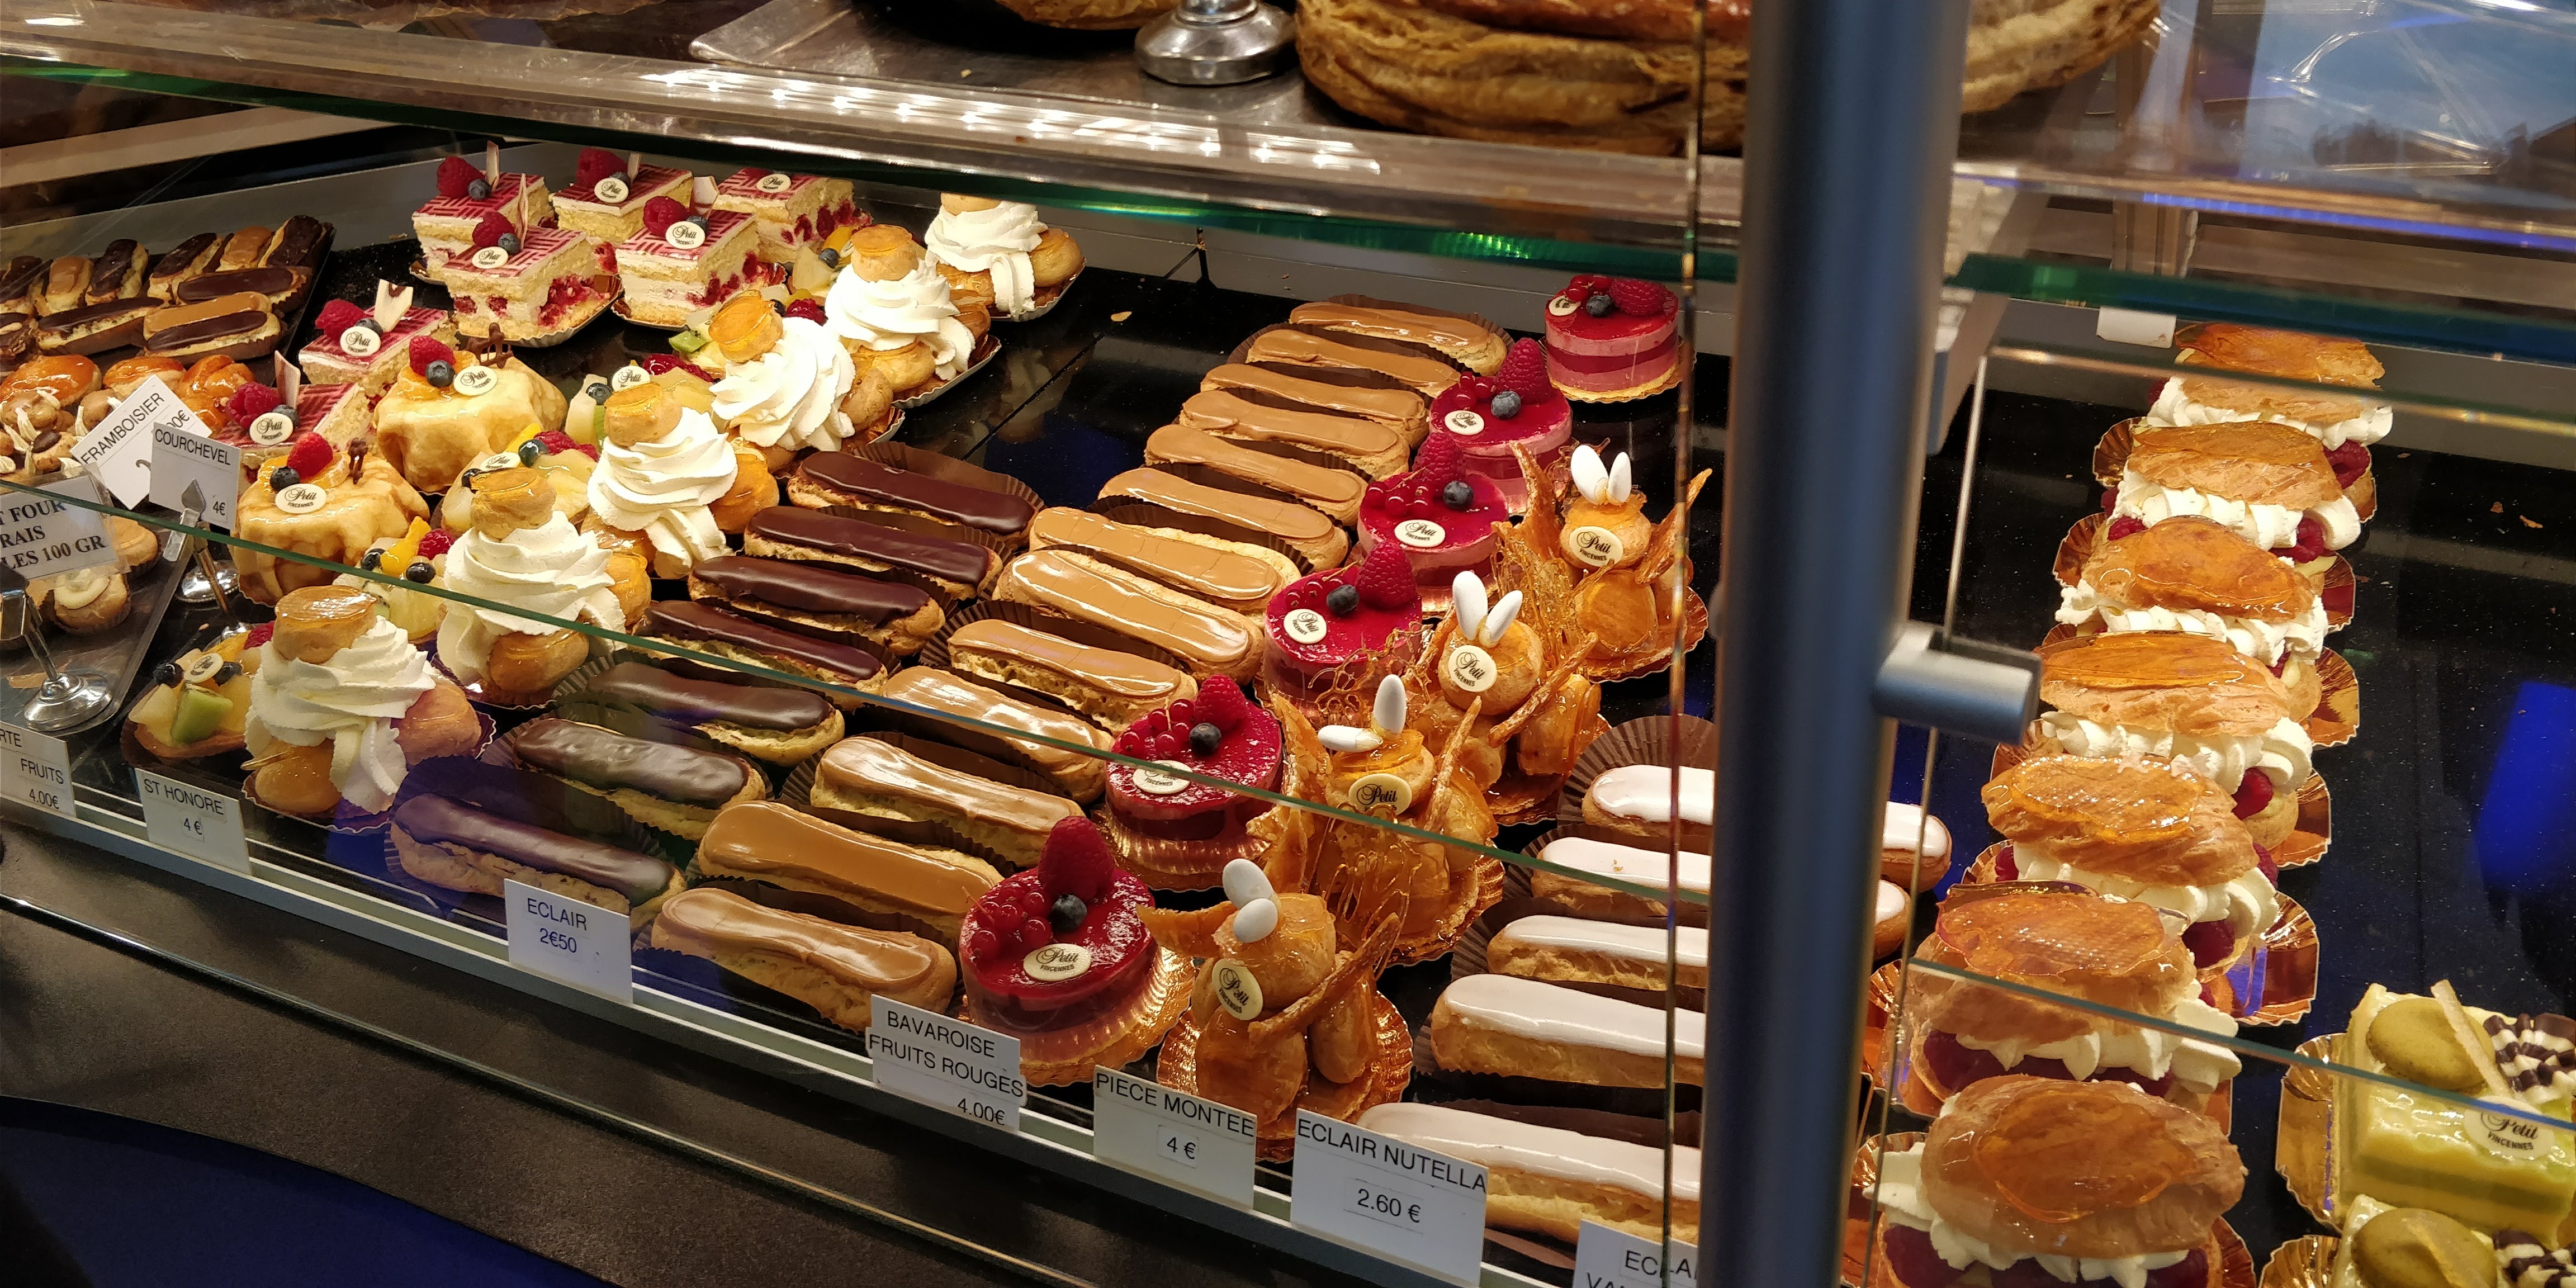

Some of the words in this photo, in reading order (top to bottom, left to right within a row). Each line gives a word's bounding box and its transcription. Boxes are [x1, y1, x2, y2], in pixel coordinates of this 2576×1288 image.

[673, 225, 697, 239] Petit
[346, 332, 371, 347] Petit
[460, 370, 487, 386] Petit
[618, 369, 641, 383] Petit
[80, 392, 165, 465] FRAMBOISIER
[257, 418, 283, 434] Petit
[155, 428, 231, 466] COURCHEVEL
[285, 487, 317, 501] Petit
[213, 501, 226, 516] 4€
[1405, 522, 1437, 537] Petit
[1405, 532, 1431, 541] VINCENNES
[41, 542, 72, 561] 100
[75, 535, 107, 553] GR
[1576, 531, 1612, 555] Petit
[1579, 548, 1607, 561] VINCENNES
[1297, 612, 1319, 633] Petit
[1453, 667, 1475, 687] VINCENNES
[1456, 651, 1485, 680] Petit
[21, 758, 64, 785] FRUITS
[1145, 776, 1173, 787] VINCENNES
[29, 788, 59, 809] 4.00€
[144, 778, 160, 795] ST
[164, 786, 224, 815] HONORE
[1356, 783, 1398, 806] Petit
[527, 897, 588, 931] ECLAIR
[539, 927, 577, 953] 2€50
[1036, 947, 1079, 964] Petit
[1040, 963, 1074, 972] VINCENNES
[1219, 967, 1251, 1007] Petit
[1219, 987, 1242, 1014] VINCENNES
[887, 1010, 995, 1058] BAVAROISE
[869, 1034, 936, 1069] FRUITS
[942, 1057, 1024, 1097] ROUGES
[957, 1098, 1006, 1126] 4.00€
[1096, 1073, 1158, 1106] PIECE
[1164, 1093, 1254, 1138] MONTEE
[2487, 1131, 2534, 1150] VINCENNES
[1298, 1118, 1376, 1159] ECLAIR
[1384, 1144, 1487, 1194] NUTELLA
[1357, 1188, 1401, 1217] 2.60
